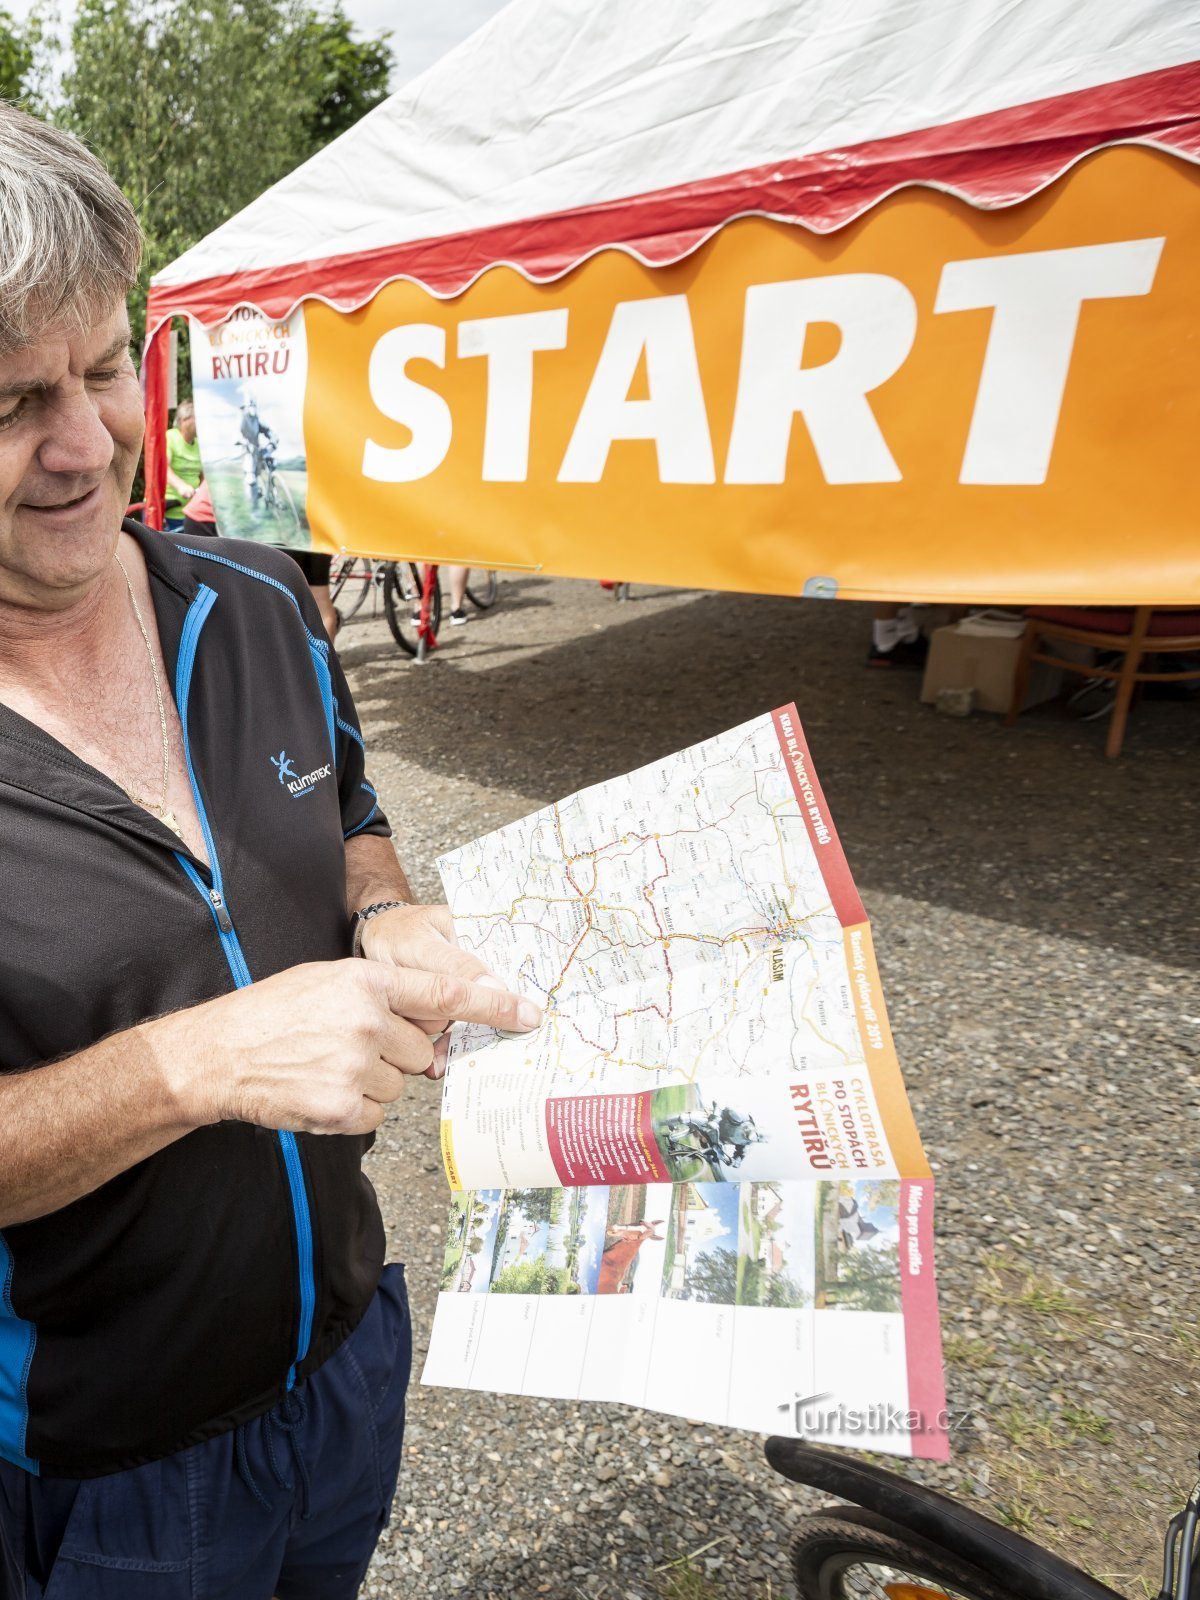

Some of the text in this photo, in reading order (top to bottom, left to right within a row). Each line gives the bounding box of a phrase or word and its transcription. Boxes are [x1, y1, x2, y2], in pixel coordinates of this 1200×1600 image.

[212, 341, 290, 380] RYTÍŘŮ
[362, 236, 1166, 485] START
[287, 763, 331, 793] KLIMATEX
[779, 713, 831, 845] KRAJ BLANICKÝCH RYTÍŘŮ
[772, 948, 787, 982] VLAŠIM
[850, 931, 869, 971] Blanický
[866, 1024, 883, 1049] 2019
[568, 1152, 576, 1162] jsou
[633, 1142, 642, 1155] hory
[789, 1084, 836, 1169] RYTÍŘŮ
[816, 1082, 850, 1169] BLANICKÝCH
[832, 1080, 869, 1168] PO STOPÁCH
[851, 1079, 886, 1167] CYKLOTRASA
[905, 1185, 923, 1275] Místo pro razítka
